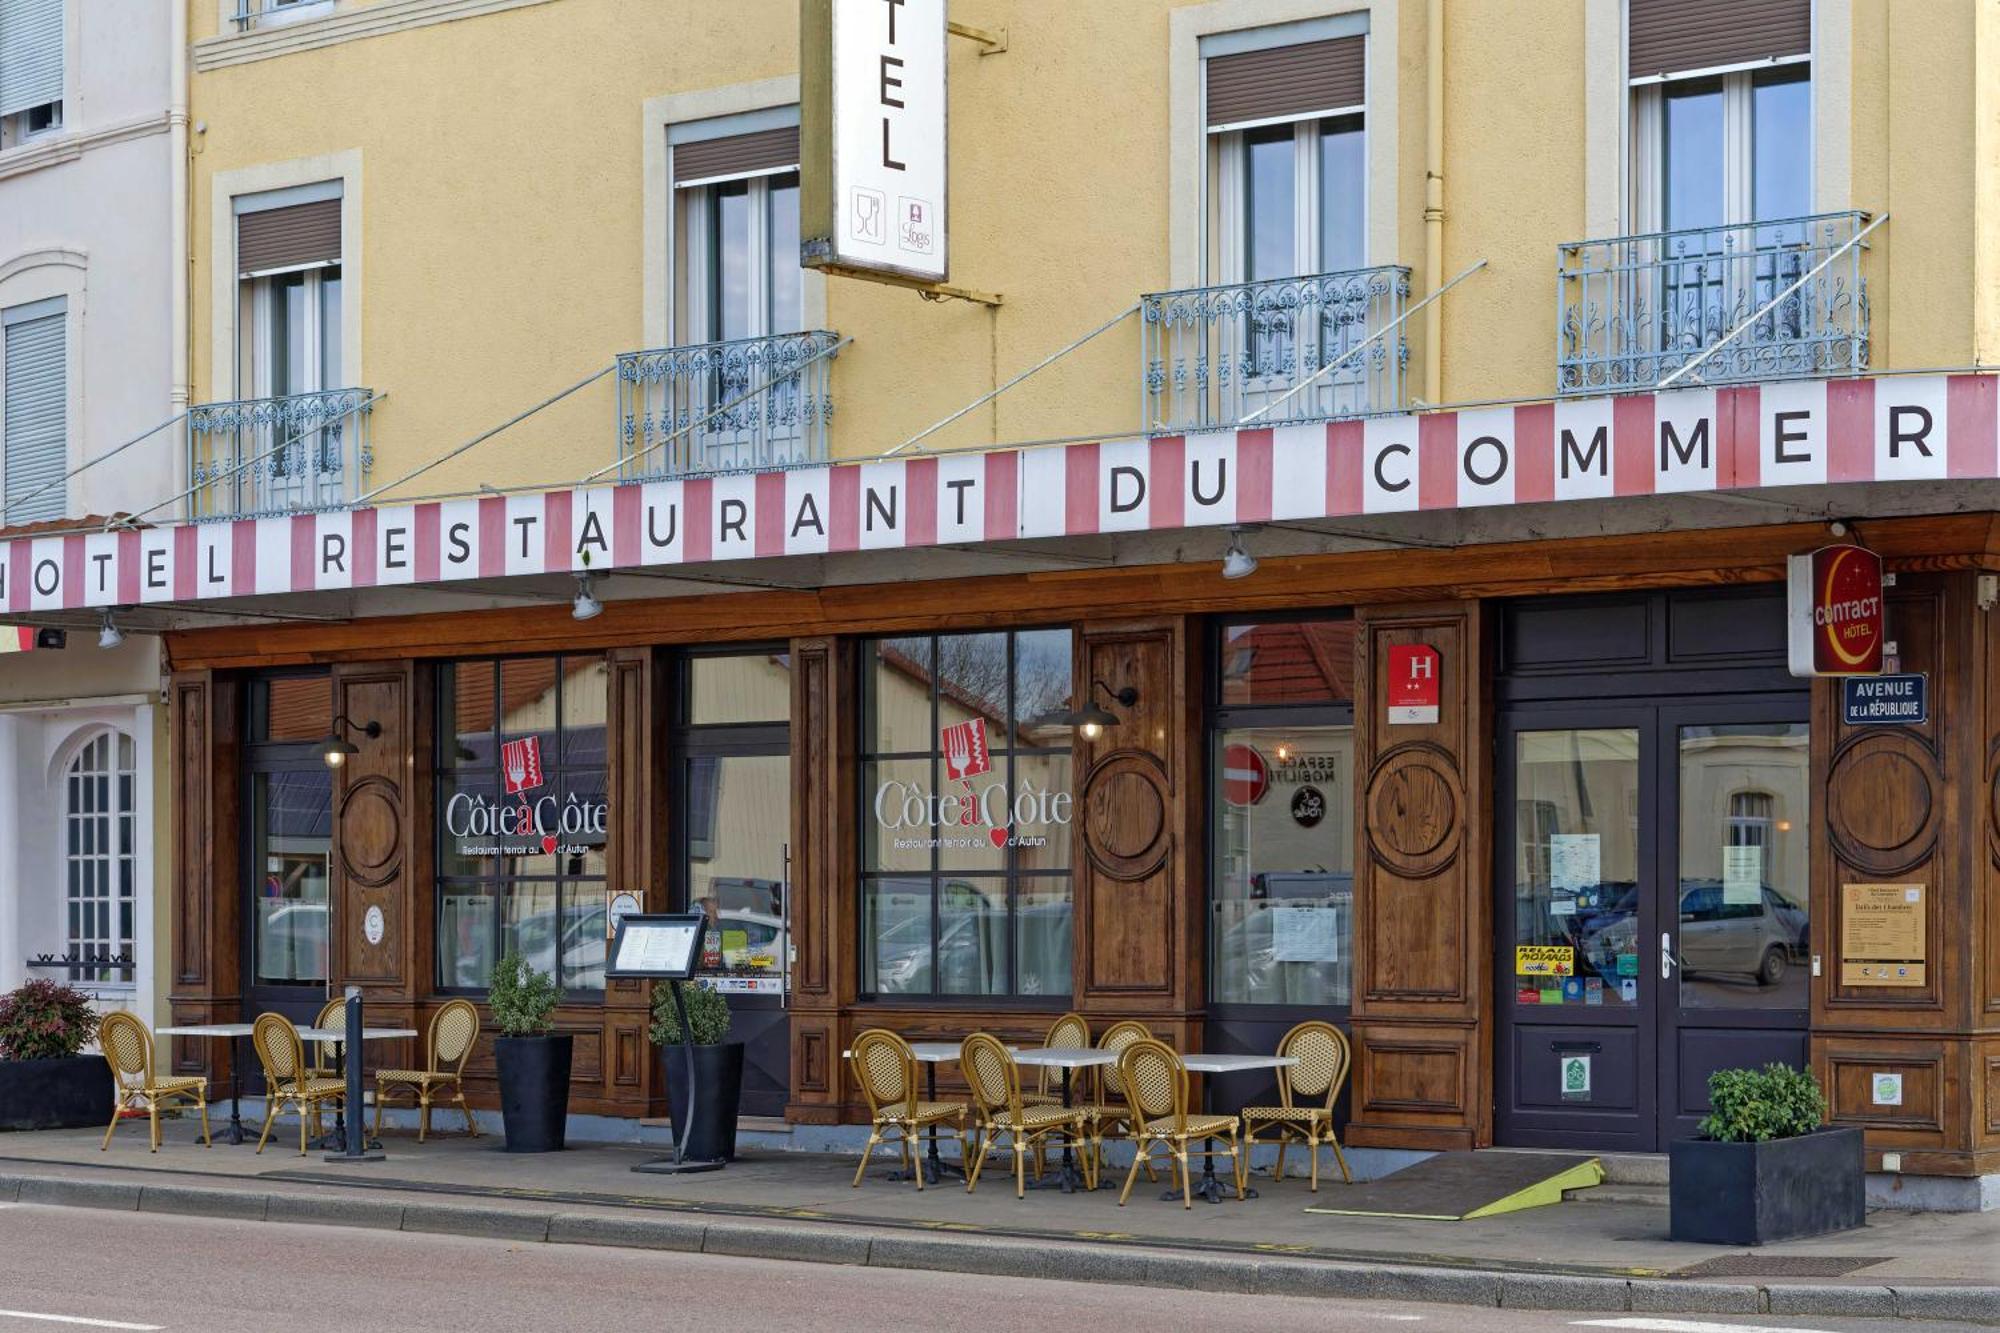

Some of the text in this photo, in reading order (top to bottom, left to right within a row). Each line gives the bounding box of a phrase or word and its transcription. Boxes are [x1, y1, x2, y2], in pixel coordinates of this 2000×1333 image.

[0, 405, 1934, 599] OTEL RESTAURANT DU COMMER
[1409, 656, 1432, 678] H
[1856, 681, 1914, 697] AVENUE
[1850, 699, 1919, 717] DE LA RÉPUBLIQUE
[875, 779, 959, 830] Côte
[980, 778, 1072, 827] Côte
[446, 792, 517, 838] Côte
[534, 792, 608, 837] Côte
[461, 845, 502, 856] Restaurant
[893, 837, 942, 849] Restaurant
